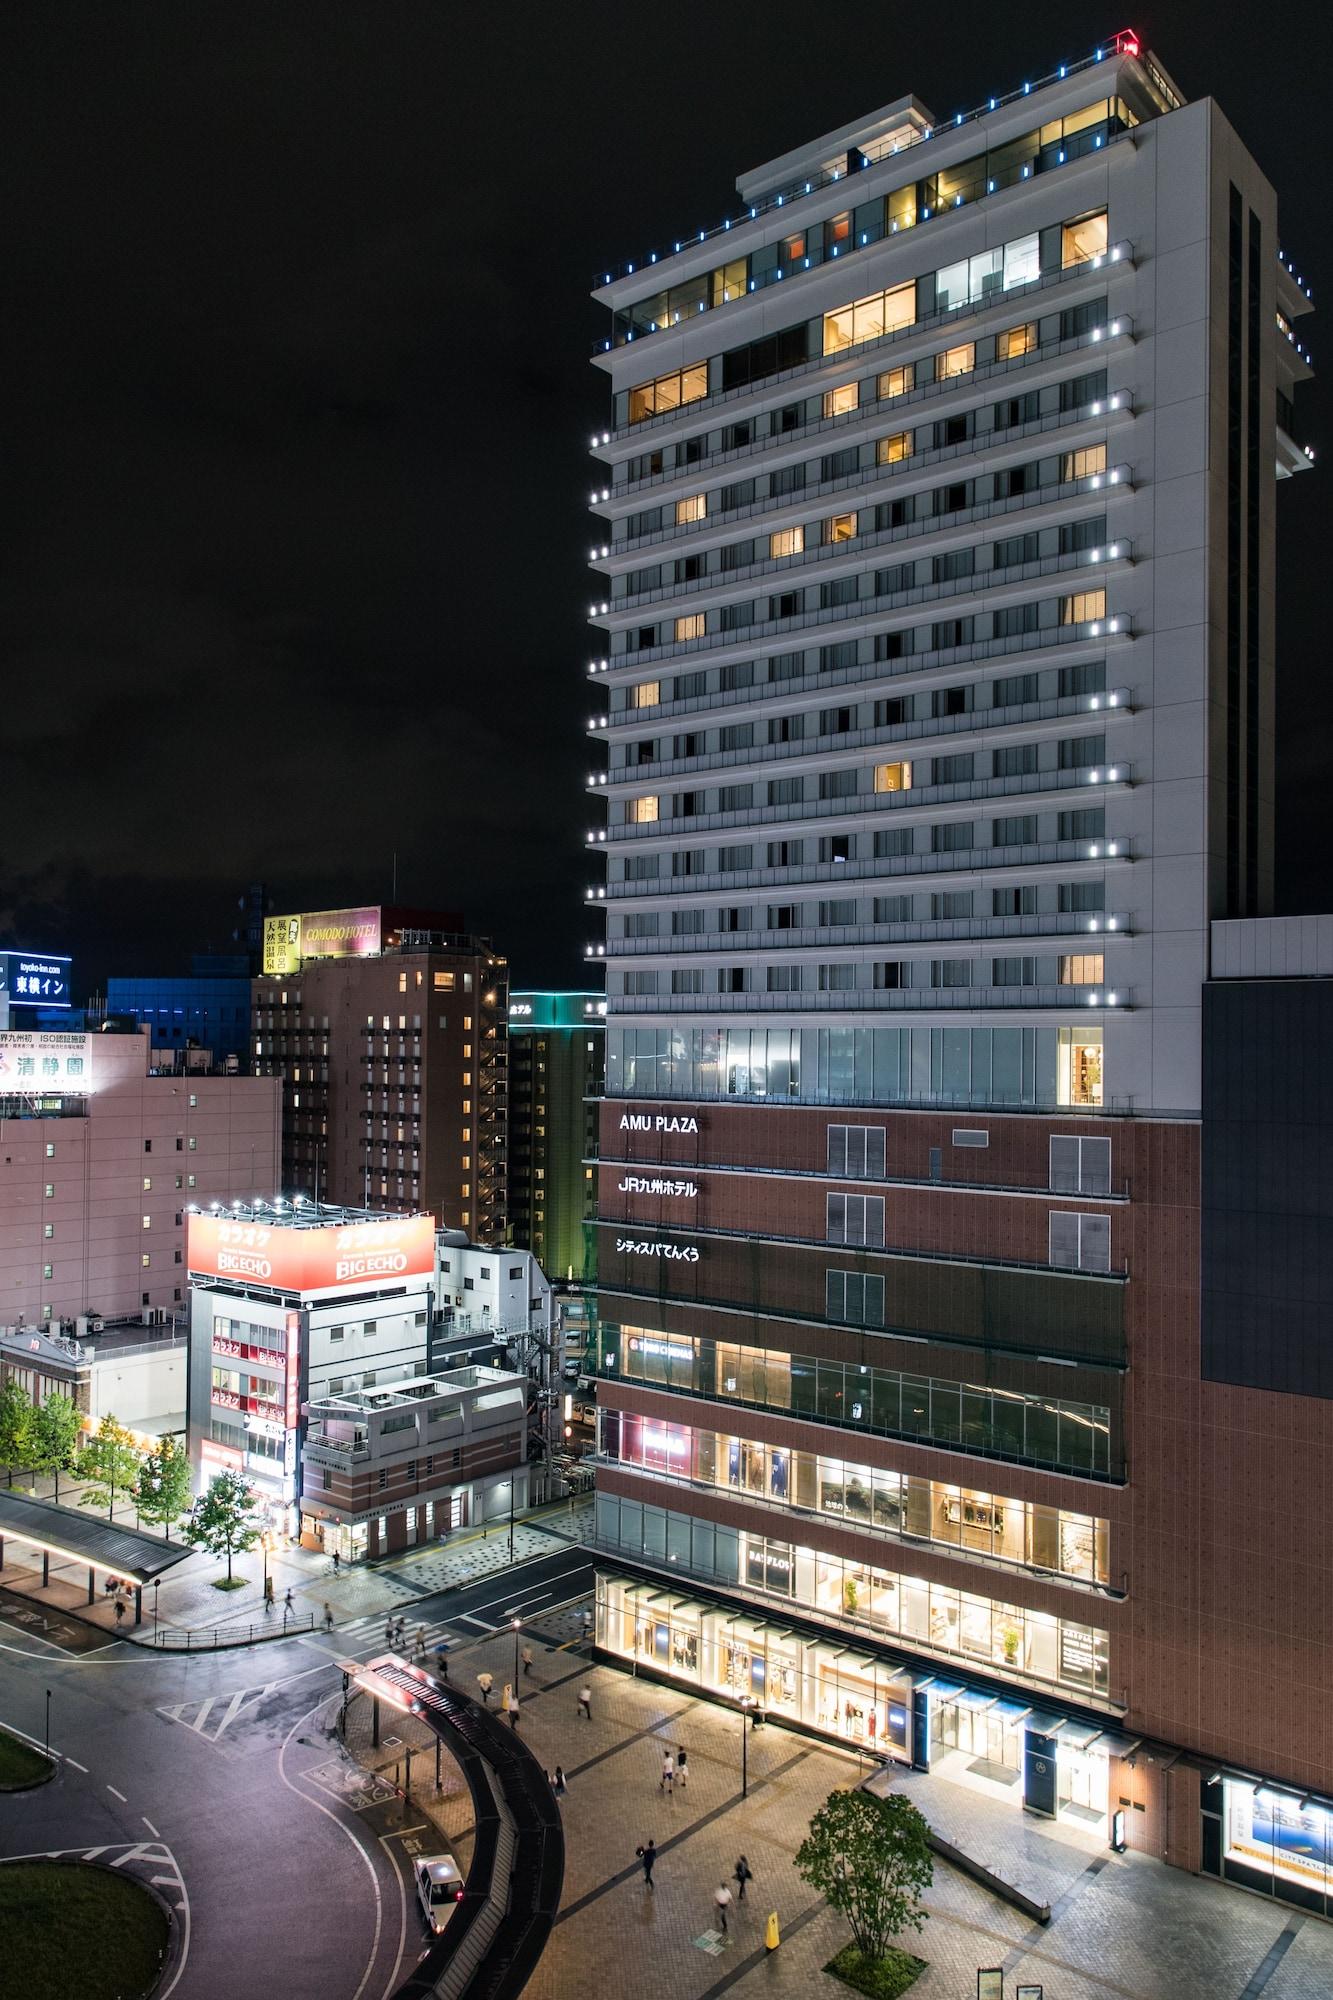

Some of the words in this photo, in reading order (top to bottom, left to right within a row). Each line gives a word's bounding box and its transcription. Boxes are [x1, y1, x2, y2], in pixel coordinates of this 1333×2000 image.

[306, 927, 345, 941] COMODO
[346, 924, 377, 939] HOTEL
[266, 921, 275, 969] 天然温泉
[277, 919, 287, 969] 展望風呂
[20, 963, 61, 974] toyoko-inn.com
[16, 976, 63, 995] 東横イン
[17, 1057, 83, 1076] 清静園
[619, 1114, 651, 1131] AMU
[656, 1116, 698, 1133] PLAZA
[618, 1177, 698, 1197] JR九州ホテル
[616, 1238, 699, 1262] シティスパてんくう
[217, 1253, 239, 1270] BIG
[240, 1256, 272, 1278] ECHO
[336, 1258, 365, 1280] BIG
[366, 1252, 408, 1271] ECHO
[213, 1340, 240, 1354] カラオケ
[212, 1391, 240, 1405] カラオケ
